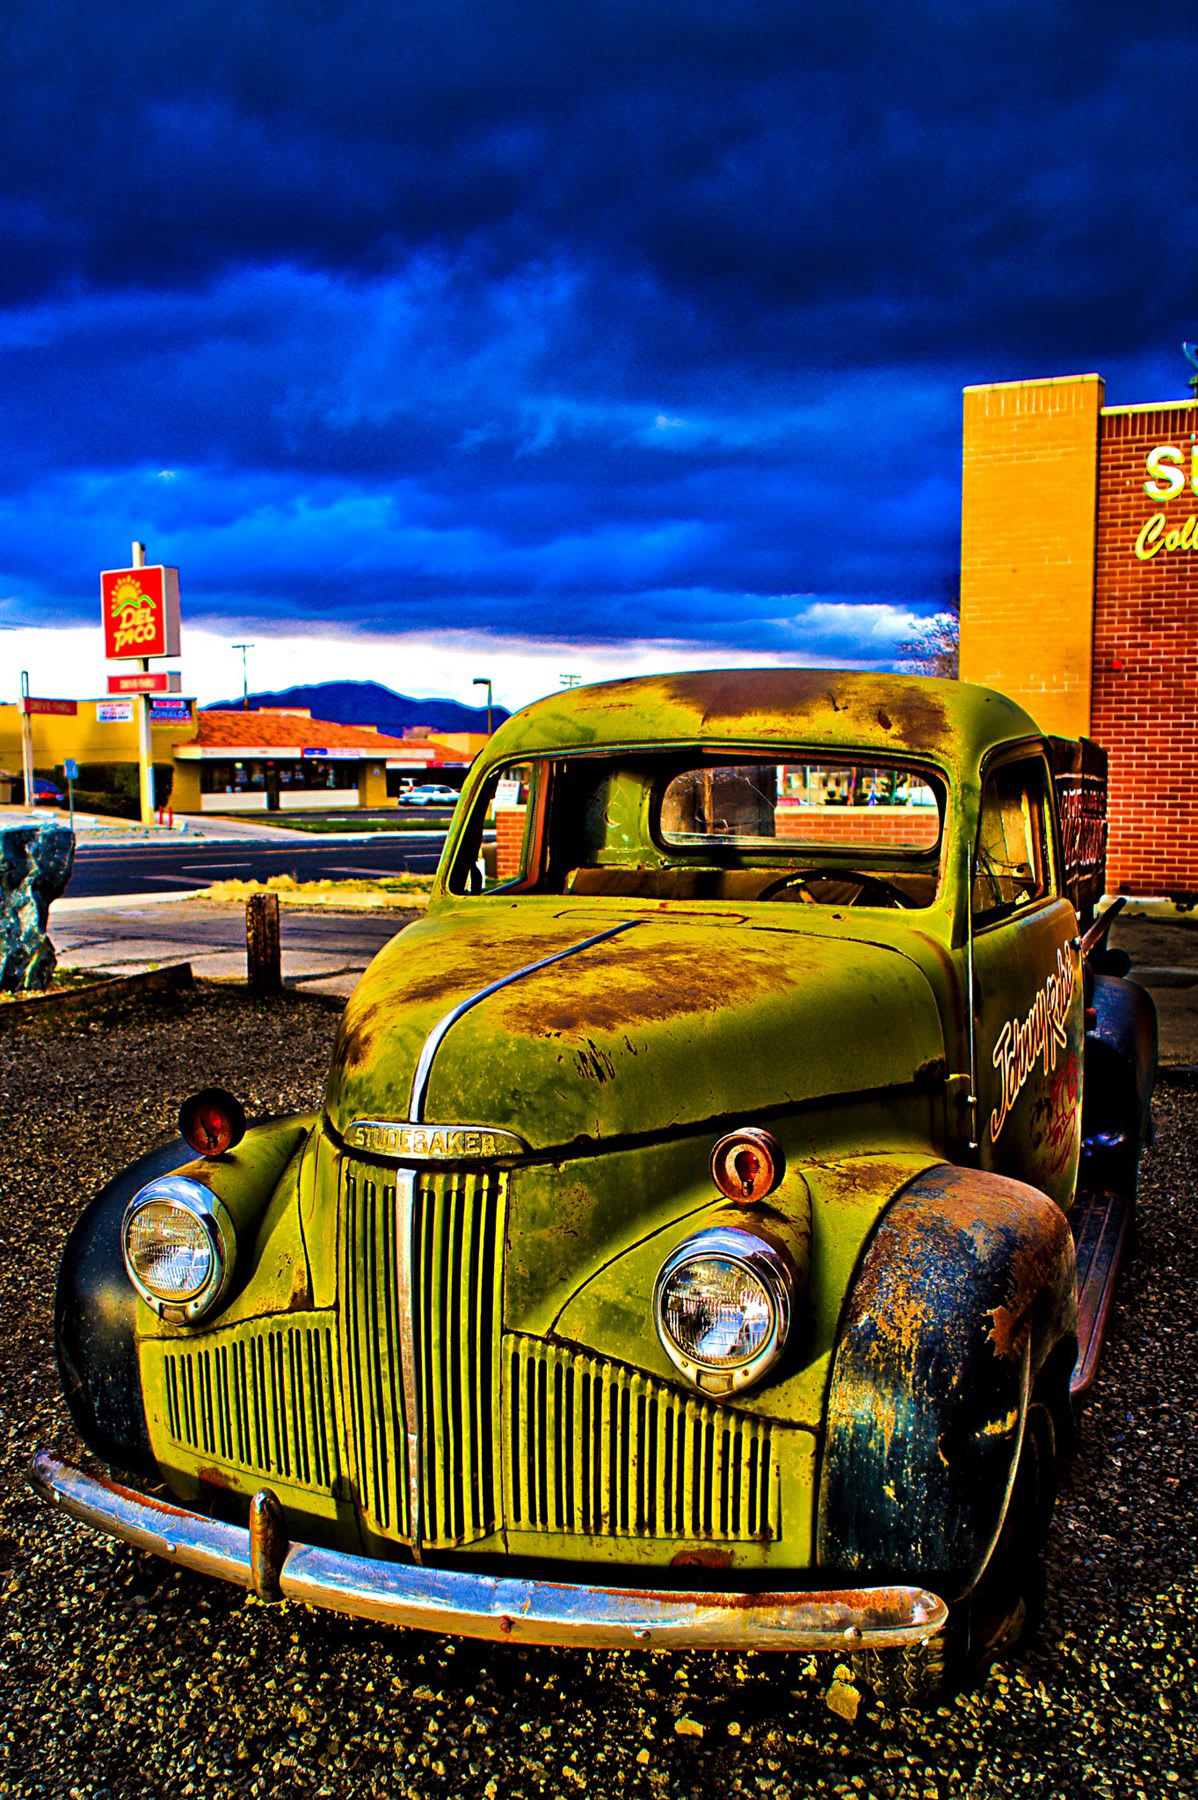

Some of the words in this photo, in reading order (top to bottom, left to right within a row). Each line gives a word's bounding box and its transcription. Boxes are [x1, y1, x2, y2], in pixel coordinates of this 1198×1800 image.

[1143, 445, 1198, 502] S
[120, 608, 155, 629] DEL
[113, 623, 156, 652] TACO
[30, 700, 71, 713] DRIVE-THRU
[990, 987, 1050, 1143] Johnny
[354, 1127, 496, 1156] STUDEBAKER
